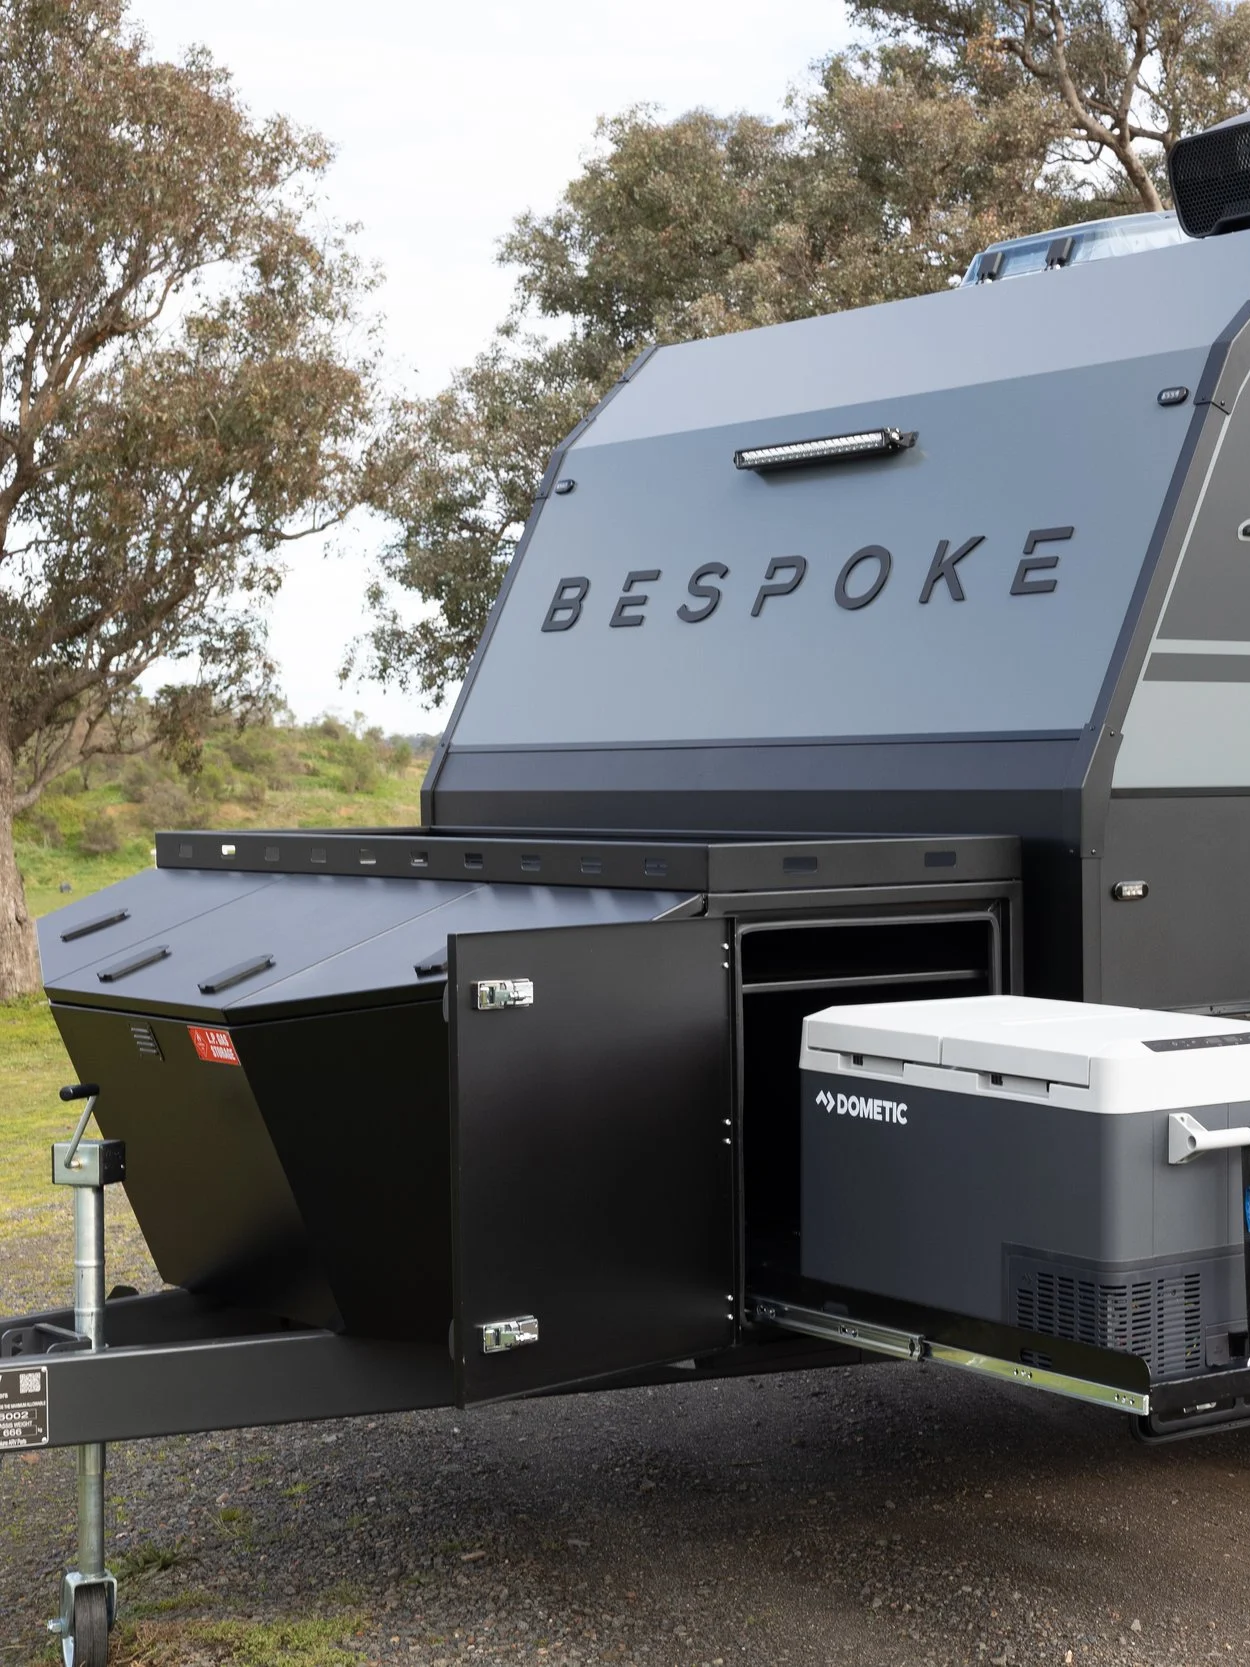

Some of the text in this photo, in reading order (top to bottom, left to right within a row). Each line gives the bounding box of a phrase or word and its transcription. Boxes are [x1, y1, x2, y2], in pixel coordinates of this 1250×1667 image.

[540, 525, 1075, 633] BESPOKE
[216, 1032, 230, 1047] GAS
[210, 1045, 236, 1060] STORAGE
[836, 1093, 908, 1125] DOMETIC
[3, 1428, 22, 1437] 666
